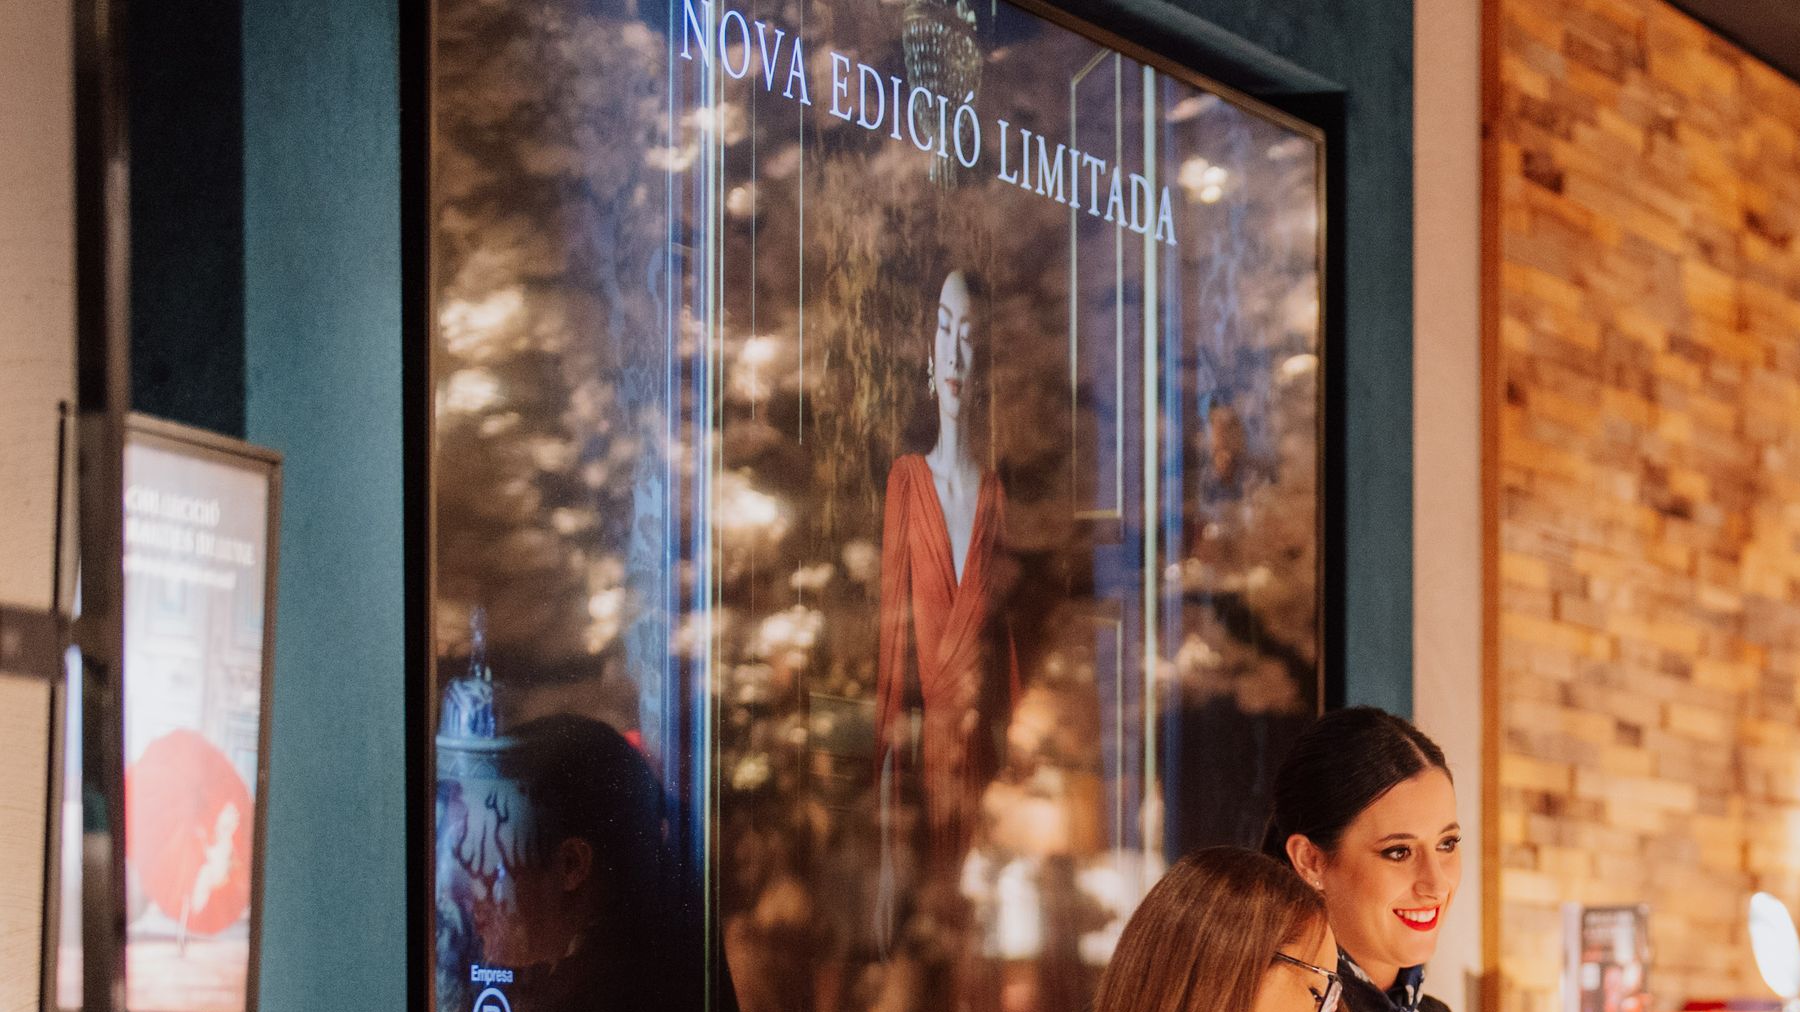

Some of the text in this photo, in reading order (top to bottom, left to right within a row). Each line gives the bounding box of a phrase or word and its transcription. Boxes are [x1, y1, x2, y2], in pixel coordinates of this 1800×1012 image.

[680, 0, 1177, 246] NOVA EDICIÓ LIMITADA
[471, 965, 513, 985] Empresa
